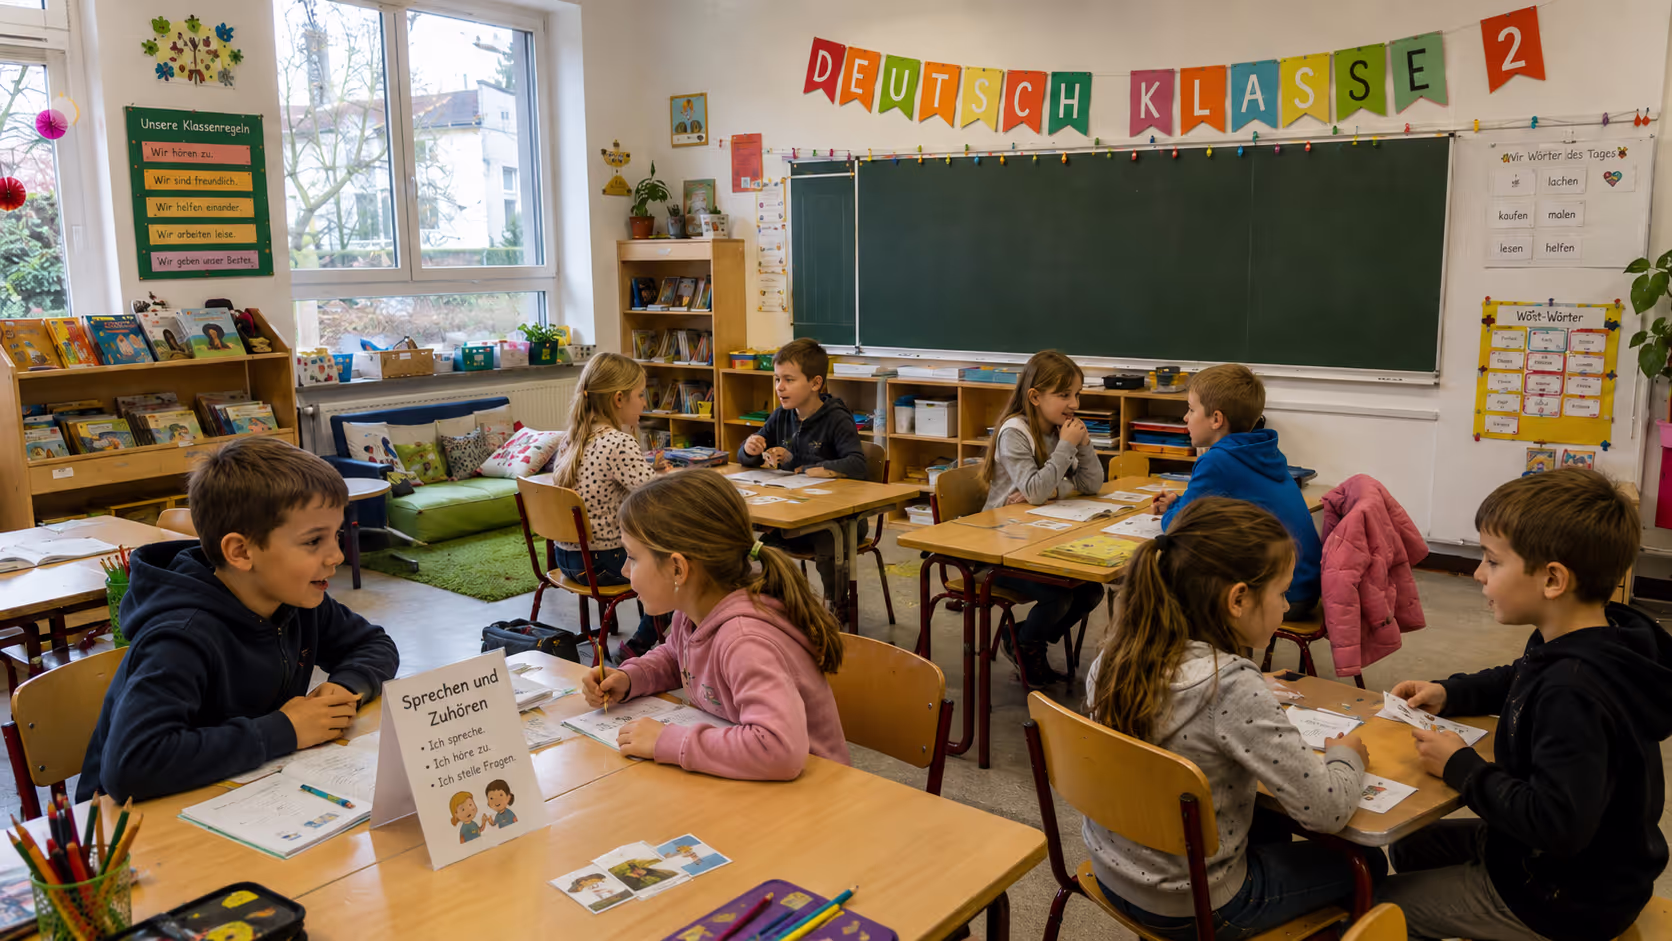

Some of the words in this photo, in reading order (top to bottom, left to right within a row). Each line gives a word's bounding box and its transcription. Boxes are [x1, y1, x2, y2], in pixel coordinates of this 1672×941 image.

[812, 49, 1080, 119] DEUTSCH
[1139, 48, 1430, 119] KLASSE
[1497, 26, 1527, 72] 2
[140, 118, 178, 130] Unsere
[183, 120, 250, 136] Klassenregeln
[151, 147, 168, 157] Wir
[1567, 149, 1583, 160] des
[1587, 148, 1616, 161] Tages
[153, 175, 171, 185] Wir
[174, 175, 192, 185] sind
[194, 175, 238, 186] freundlich.
[1548, 176, 1579, 186] lachen
[155, 202, 173, 212] Wir
[176, 202, 203, 212] helfen
[1498, 210, 1528, 221] kaufen
[1548, 210, 1576, 219] malen
[156, 229, 174, 239] Wir
[177, 229, 212, 239] arbeiten
[215, 229, 236, 239] leise.
[1499, 243, 1523, 253] lesen
[1545, 242, 1575, 253] helfen
[157, 257, 173, 266] Wir
[177, 255, 200, 268] geben
[402, 683, 469, 711] Sprechen
[473, 668, 499, 689] und
[427, 698, 488, 727] Zuhören
[429, 737, 445, 751] Ich
[448, 726, 485, 745] spreche.
[434, 755, 450, 769] Ich
[478, 743, 491, 755] zu.
[438, 775, 454, 788] Ich
[457, 765, 481, 781] stelle
[483, 754, 516, 772] Fragen.
